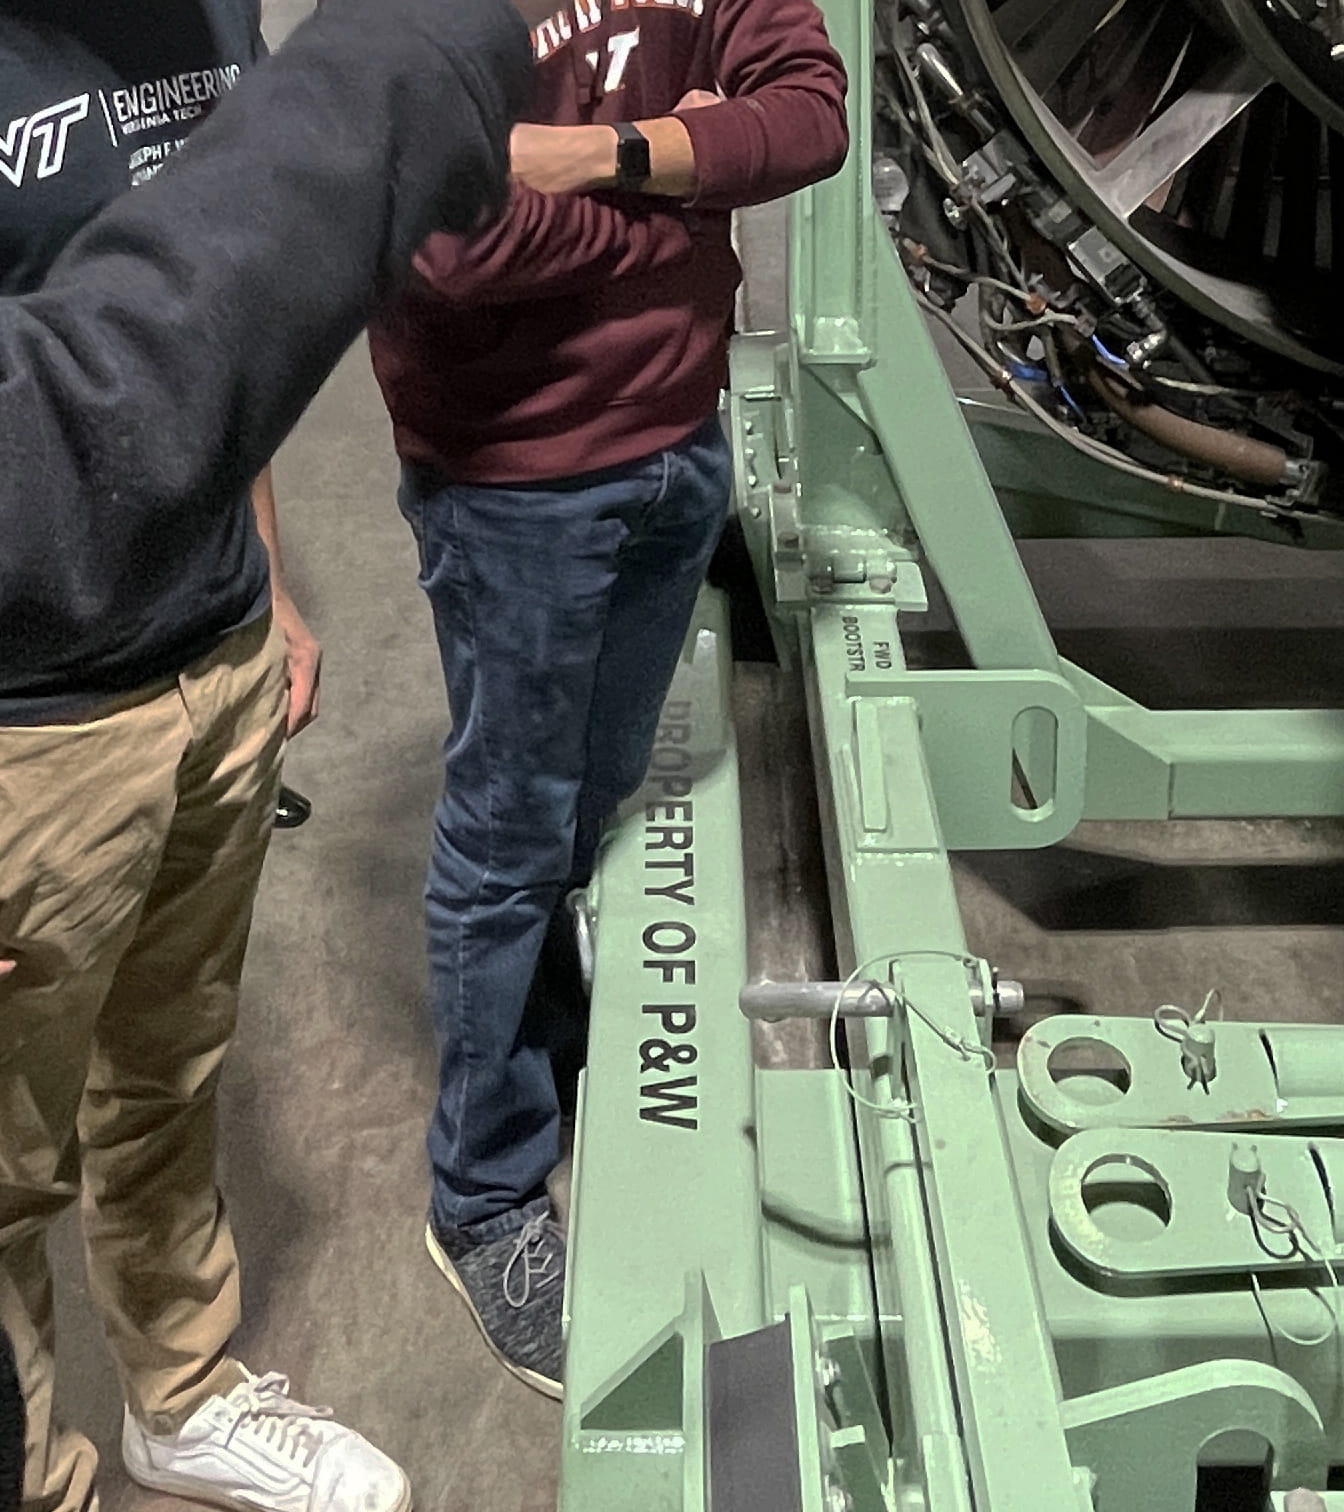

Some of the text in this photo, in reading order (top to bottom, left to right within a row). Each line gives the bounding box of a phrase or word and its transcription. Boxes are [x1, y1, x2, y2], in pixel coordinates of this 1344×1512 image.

[872, 641, 893, 669] FWD
[641, 920, 697, 985] OF
[638, 1003, 698, 1131] P&W
